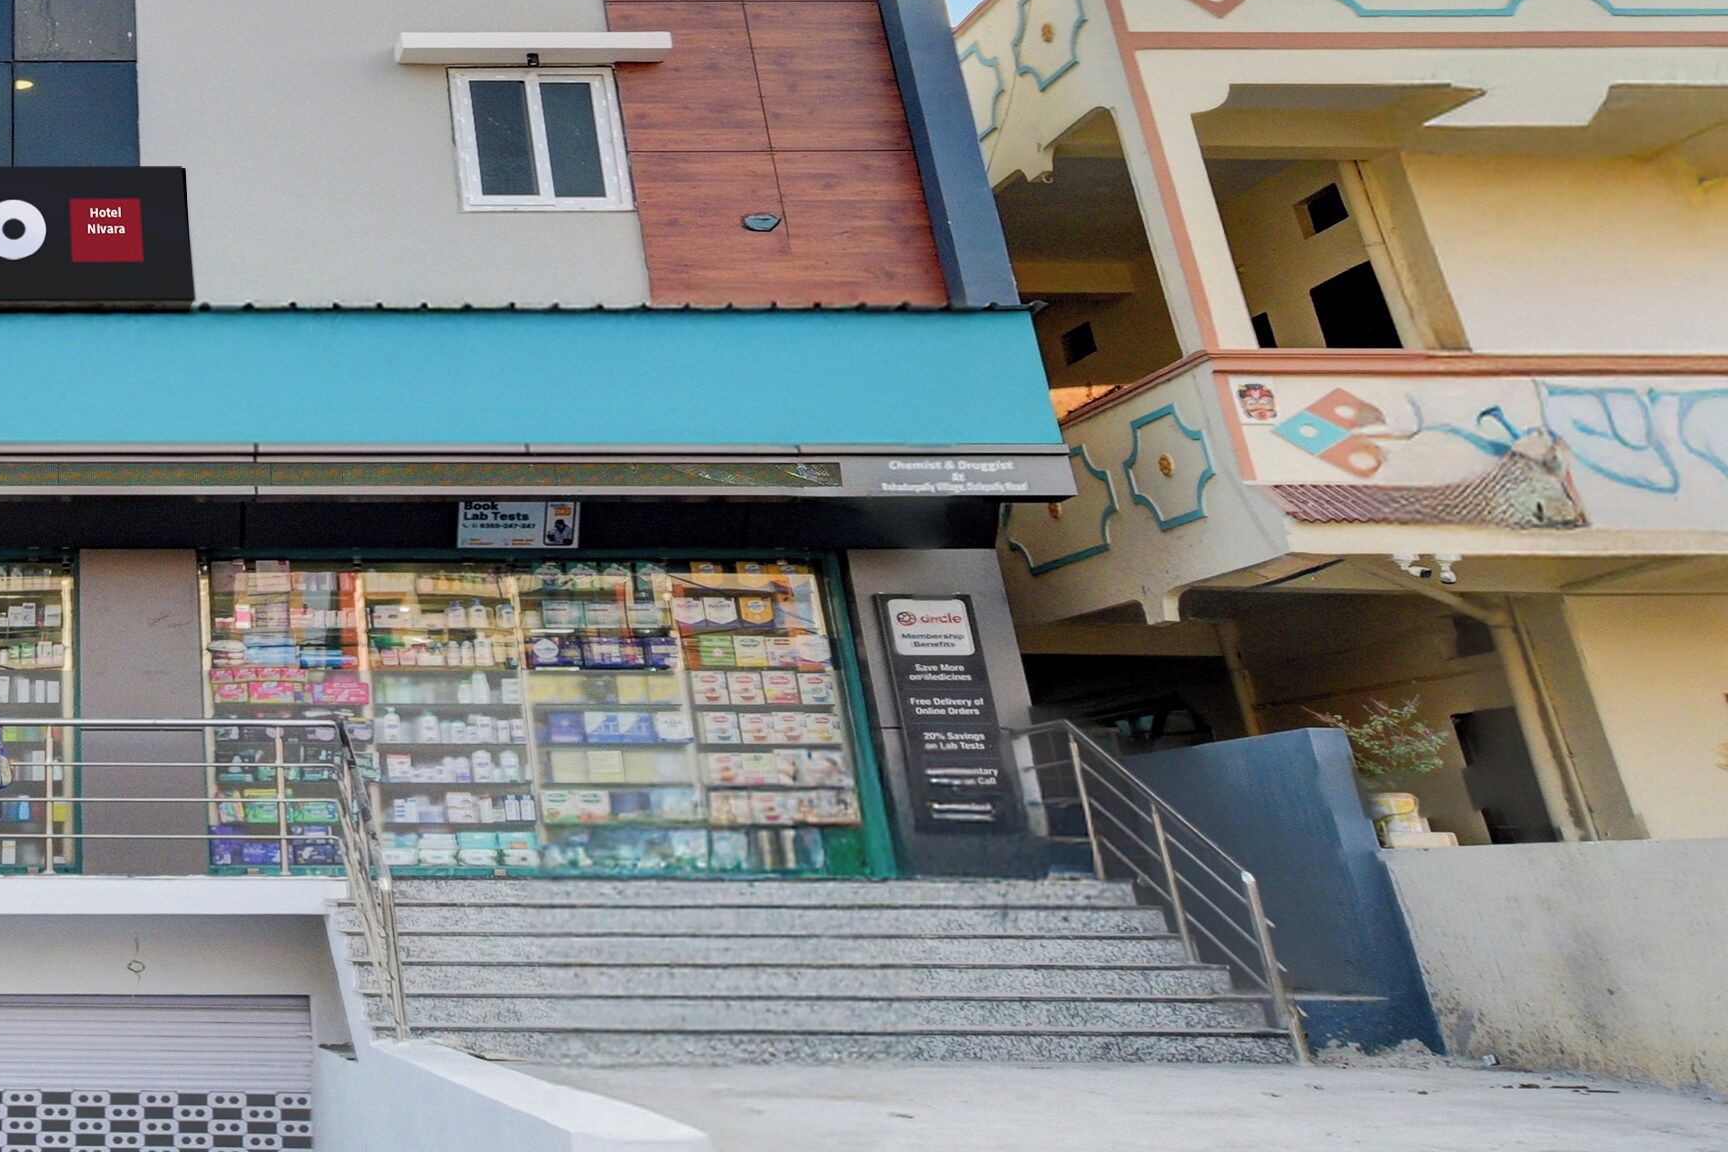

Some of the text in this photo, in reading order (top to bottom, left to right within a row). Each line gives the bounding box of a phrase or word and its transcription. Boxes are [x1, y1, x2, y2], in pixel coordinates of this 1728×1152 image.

[89, 207, 122, 218] Hotel
[87, 223, 126, 234] Nivara
[889, 460, 1015, 472] Chemist & Druggist
[464, 500, 499, 510] Book
[463, 512, 530, 521] Lab Tests
[920, 613, 962, 624] circle
[915, 663, 965, 671] Save More
[922, 673, 972, 681] Medicines
[910, 697, 931, 705] Free
[933, 697, 971, 706] Delivery
[915, 707, 980, 715] Online Orders
[923, 732, 985, 741] 20% Savings
[960, 742, 985, 750] Tests
